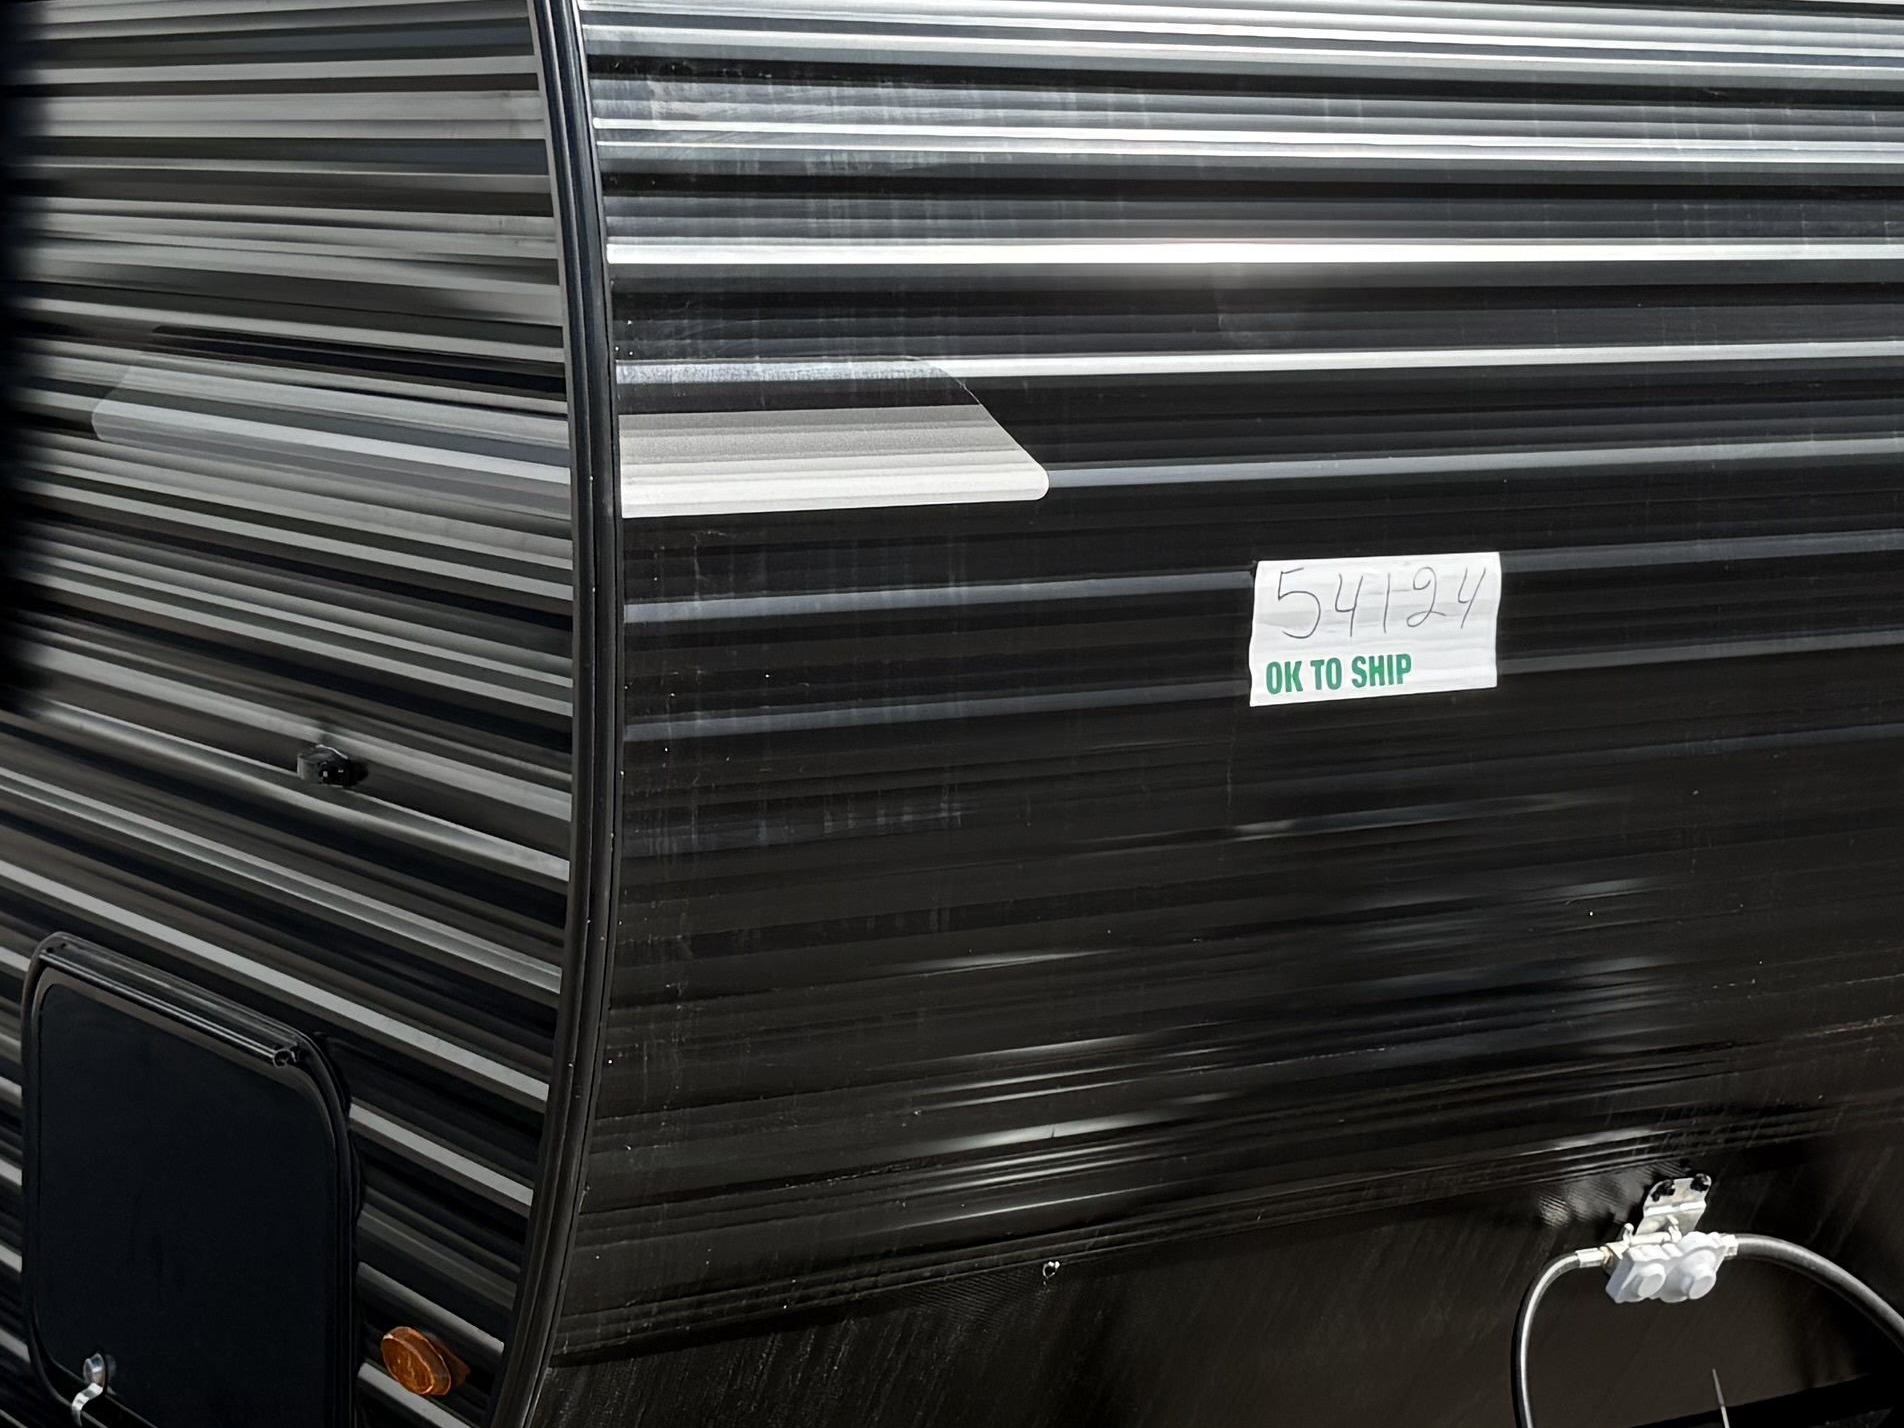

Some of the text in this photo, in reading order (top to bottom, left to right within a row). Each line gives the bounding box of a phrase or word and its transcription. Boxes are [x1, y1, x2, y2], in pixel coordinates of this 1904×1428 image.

[1276, 565, 1487, 641] 54124
[1265, 652, 1413, 696] OK TO SHIP
